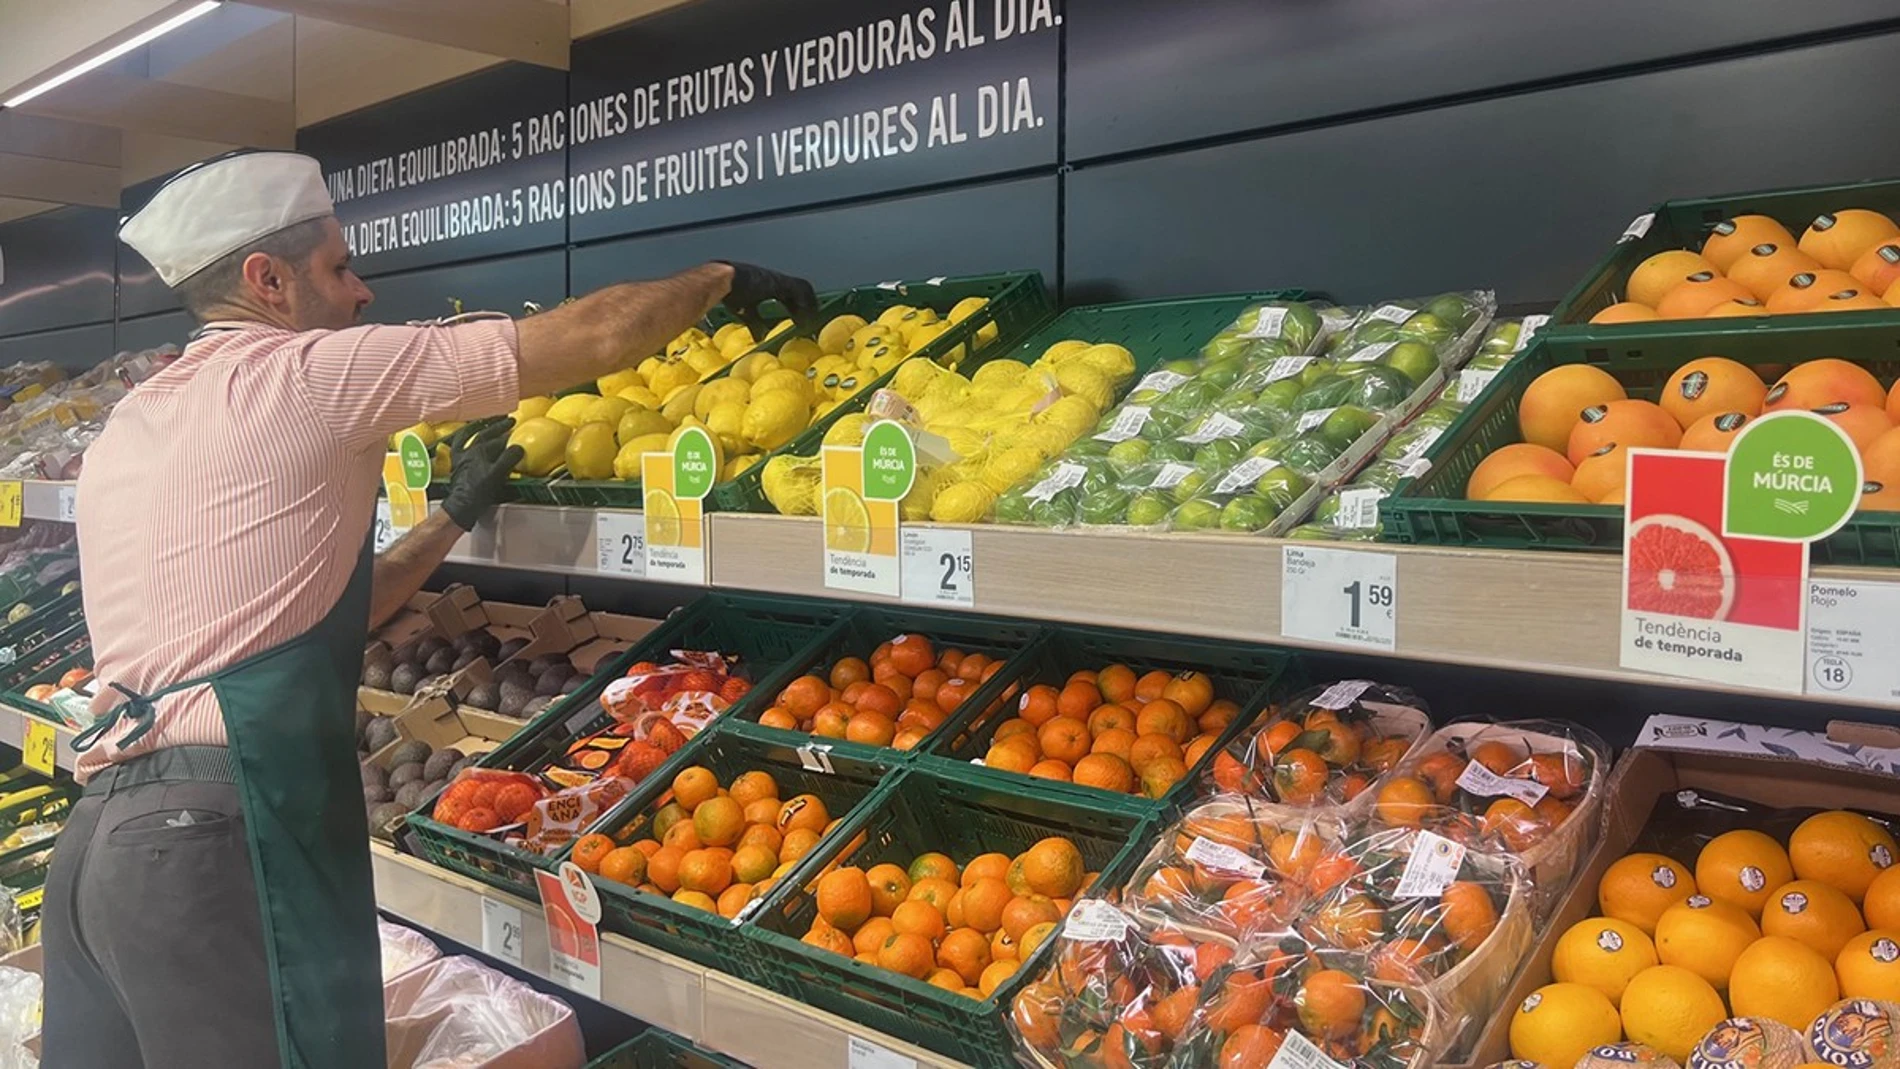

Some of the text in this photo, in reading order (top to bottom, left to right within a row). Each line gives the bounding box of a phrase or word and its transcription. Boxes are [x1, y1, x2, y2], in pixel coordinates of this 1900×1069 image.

[329, 169, 355, 203] UNA
[357, 156, 395, 198] DIETA
[399, 127, 507, 188] EQUILIBRADA:
[512, 121, 523, 160] 5
[634, 83, 660, 130] DE
[667, 56, 755, 122] FRUTAS
[761, 50, 778, 97] Y
[784, 7, 937, 92] VERDURAS
[945, 0, 985, 53] AL
[360, 215, 398, 256] DIETA
[401, 191, 511, 248] EQUILIBRADA:
[512, 188, 523, 227] 5
[622, 161, 648, 206] DE
[655, 138, 748, 198] FRUITES
[757, 135, 764, 181] I
[771, 101, 919, 178] VERDURES
[927, 92, 967, 149] AL
[978, 76, 1045, 139] DIA.
[1772, 451, 1814, 470] ÉS DE
[1753, 470, 1832, 494] MÚRCIA
[622, 533, 633, 565] 2
[940, 552, 957, 590] 2
[957, 555, 971, 573] 15
[1343, 580, 1361, 628] 1
[1369, 584, 1393, 607] 59
[1811, 585, 1857, 598] Pomelo
[1811, 595, 1838, 608] Rojo
[1635, 617, 1722, 644] Tendència
[1634, 635, 1743, 663] de temporada
[1823, 667, 1845, 683] 18
[548, 796, 580, 811] ENCI
[552, 809, 580, 822] ANA
[503, 922, 512, 951] 2
